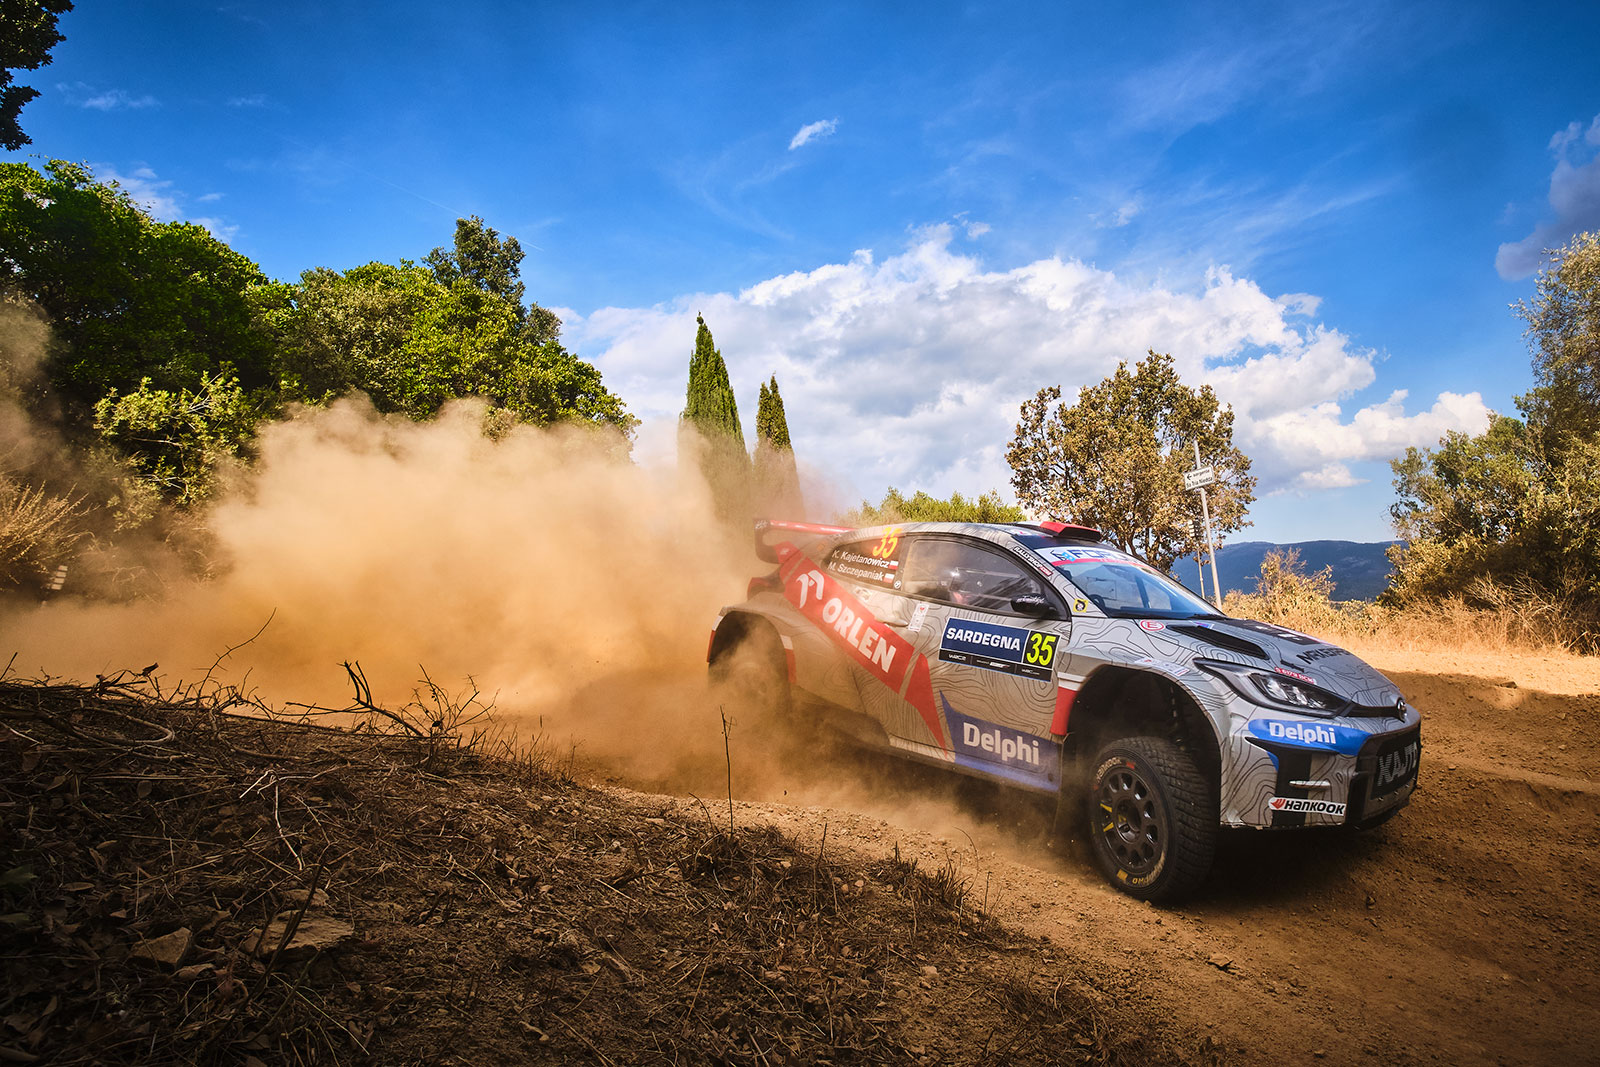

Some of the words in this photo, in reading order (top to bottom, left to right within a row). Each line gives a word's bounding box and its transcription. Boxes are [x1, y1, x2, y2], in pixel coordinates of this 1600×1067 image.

[872, 526, 903, 559] 35
[827, 561, 837, 571] M.
[837, 563, 885, 581] Szczepaniak
[832, 549, 840, 559] K.
[840, 551, 890, 569] Kajetanowicz
[822, 597, 897, 673] ORLEN
[946, 627, 1021, 651] SARDEGNA
[1026, 633, 1056, 666] 35
[963, 722, 1040, 766] Delphi
[1269, 722, 1337, 745] Delphi
